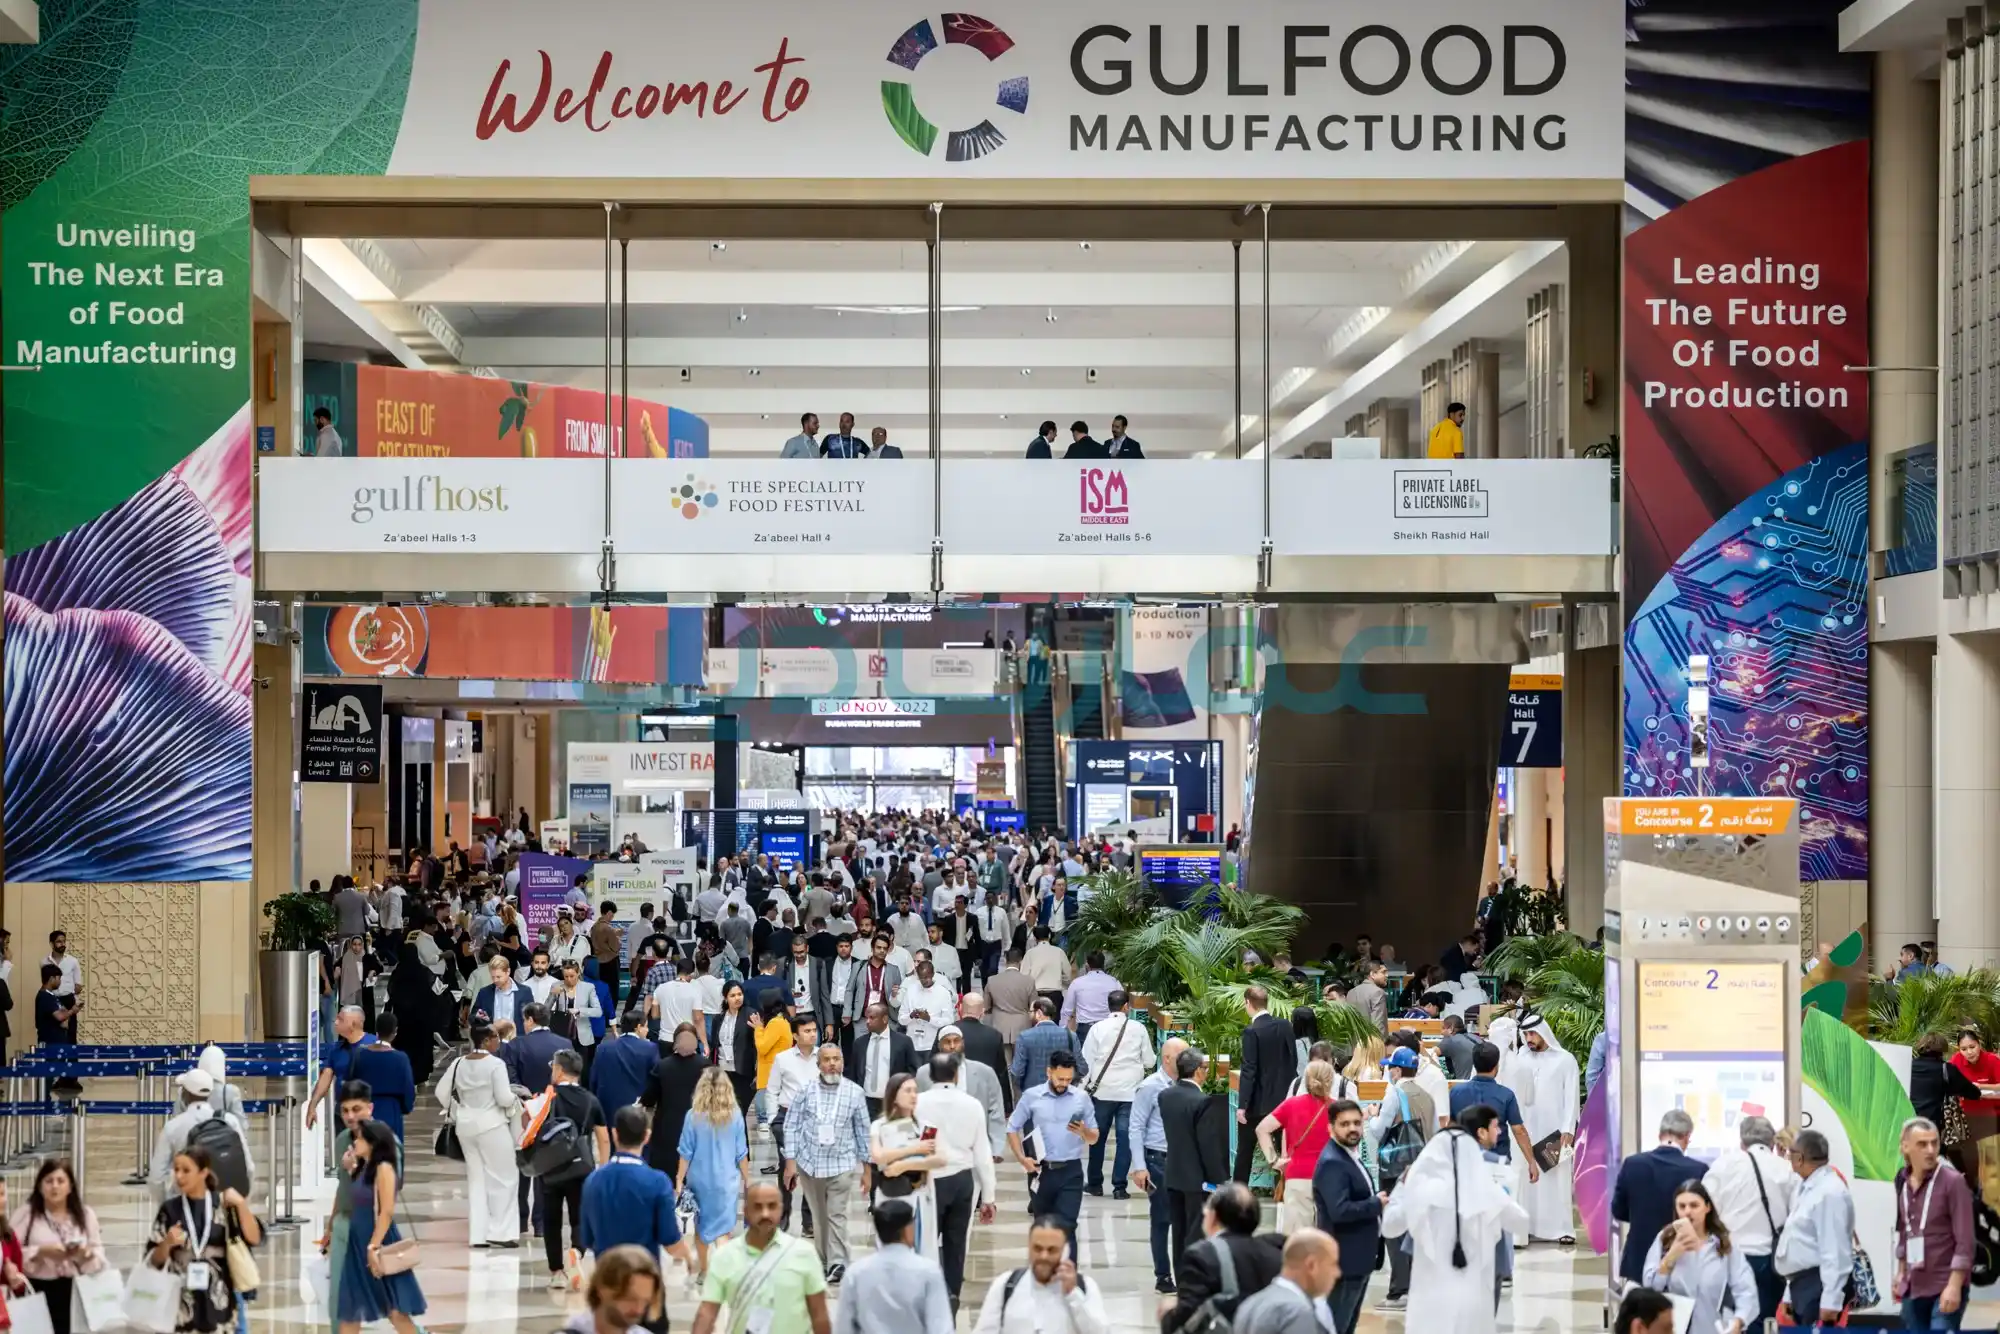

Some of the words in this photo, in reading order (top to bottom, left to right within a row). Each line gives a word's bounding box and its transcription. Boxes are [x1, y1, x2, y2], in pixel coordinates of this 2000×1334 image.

[1070, 24, 1566, 96] GULFOOD
[475, 49, 749, 140] Welcome
[754, 37, 810, 122] to
[1070, 114, 1566, 151] MANUFACTURING
[57, 223, 196, 252] Unveiling
[28, 262, 84, 286] The
[95, 262, 164, 286] Next
[175, 262, 224, 286] Era
[1673, 257, 1820, 291] Leading
[69, 301, 99, 325] of
[109, 301, 184, 325] Food
[1645, 298, 1713, 326] The
[1728, 298, 1847, 326] Future
[17, 340, 236, 370] Manufacturing
[1672, 339, 1714, 367] Of
[1729, 339, 1819, 367] Food
[1644, 380, 1848, 408] Production
[377, 400, 417, 436] FEAST
[420, 402, 436, 437] OF
[565, 418, 590, 453] FROM
[728, 480, 763, 493] THE
[767, 480, 866, 493] SPECIALITY
[1403, 479, 1445, 493] PRIVATE
[1450, 479, 1482, 493] LABEL
[351, 475, 510, 523] gulfhost
[728, 499, 778, 513] FOOD
[783, 499, 866, 513] FESTIVAL
[1403, 496, 1411, 509] &
[1414, 496, 1467, 509] LICENSING
[1082, 516, 1107, 524] MIDDLE
[1109, 516, 1128, 524] EAST
[431, 533, 457, 542] Halls
[461, 534, 477, 542] 1-3
[802, 533, 821, 542] Hall
[824, 533, 831, 542] 4
[1105, 533, 1131, 541] Halls
[1134, 533, 1152, 541] 5-6
[1393, 531, 1427, 540] Sheikh
[1431, 531, 1466, 540] Rashid
[1470, 531, 1490, 540] Hall
[1128, 608, 1201, 619] Production
[854, 703, 887, 713] NOV
[894, 703, 929, 713] 2022
[1509, 694, 1540, 705] قاعة
[1514, 708, 1535, 719] Hall
[306, 744, 331, 752] Female
[332, 745, 355, 753] Prayer
[1511, 721, 1537, 763] 7
[630, 752, 687, 771] INVEST
[1635, 815, 1693, 826] Concourse
[1699, 804, 1714, 828] 2
[1644, 978, 1700, 988] Concourse
[1706, 969, 1719, 990] 2
